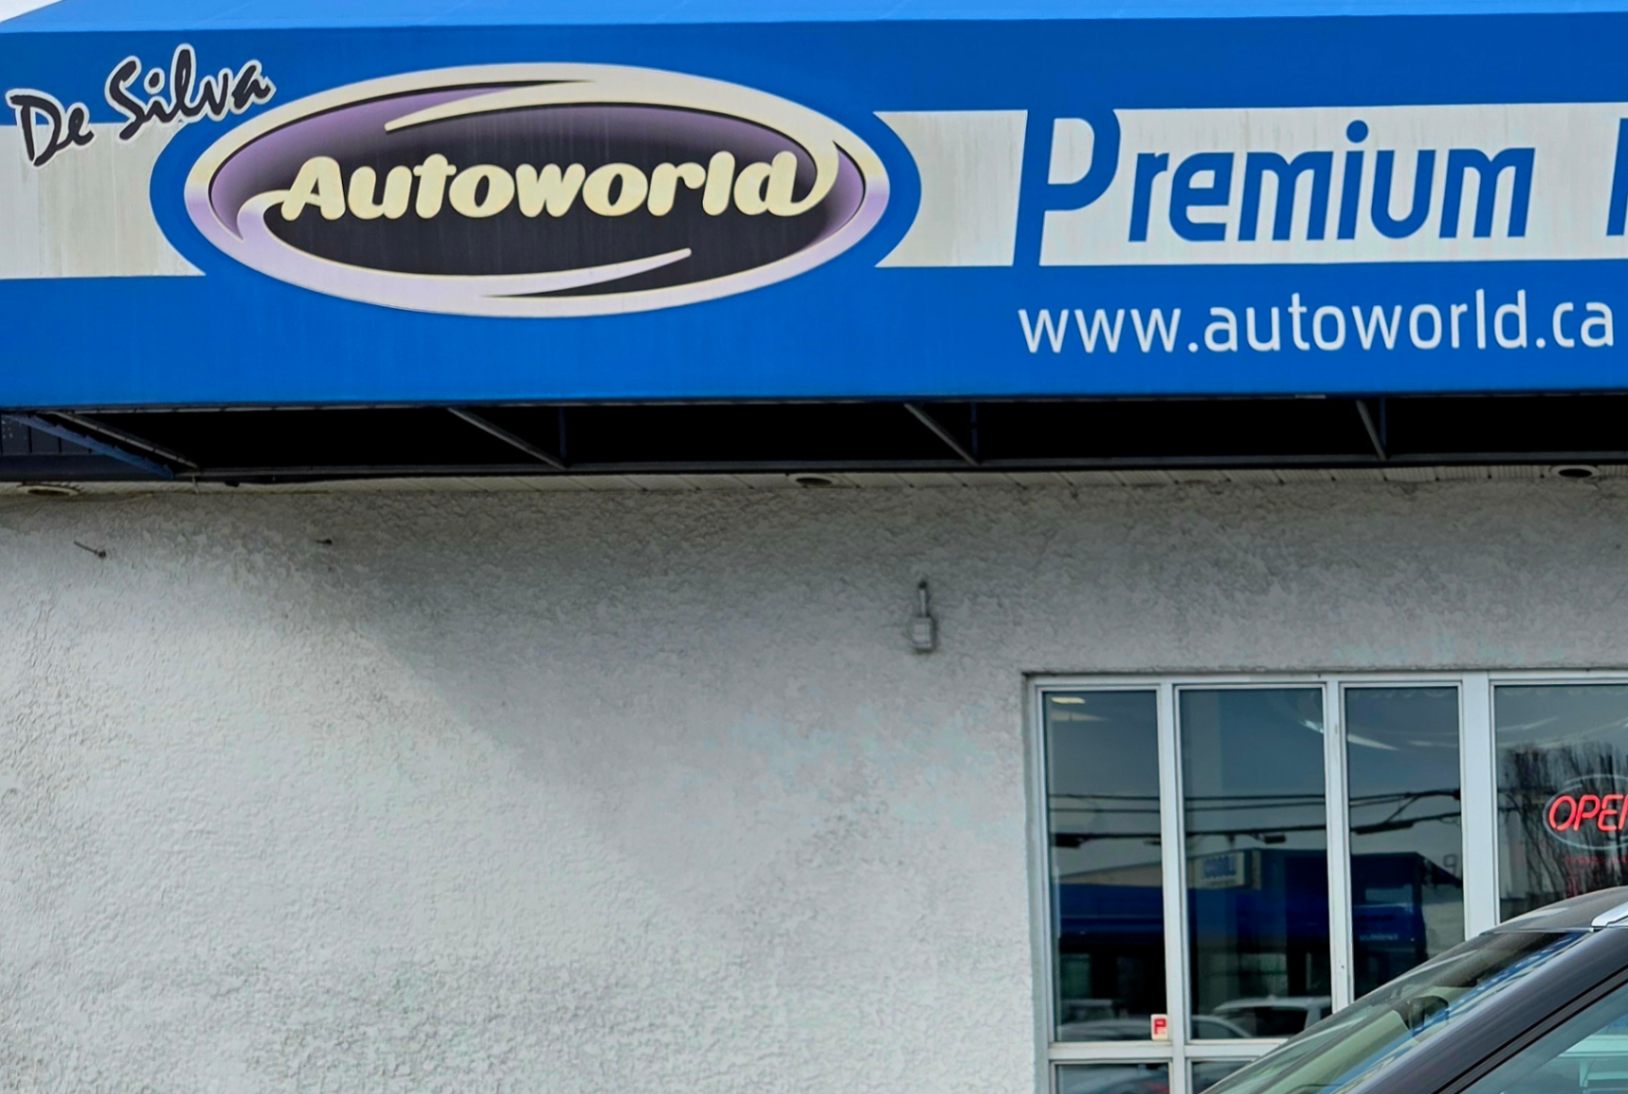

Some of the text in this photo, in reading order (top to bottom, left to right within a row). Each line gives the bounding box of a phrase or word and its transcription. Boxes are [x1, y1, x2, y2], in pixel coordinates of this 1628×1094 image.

[9, 48, 272, 167] De Silva
[278, 150, 830, 221] Autoworld
[1012, 110, 1536, 266] Premium
[1018, 288, 1614, 353] www.autoworld.ca
